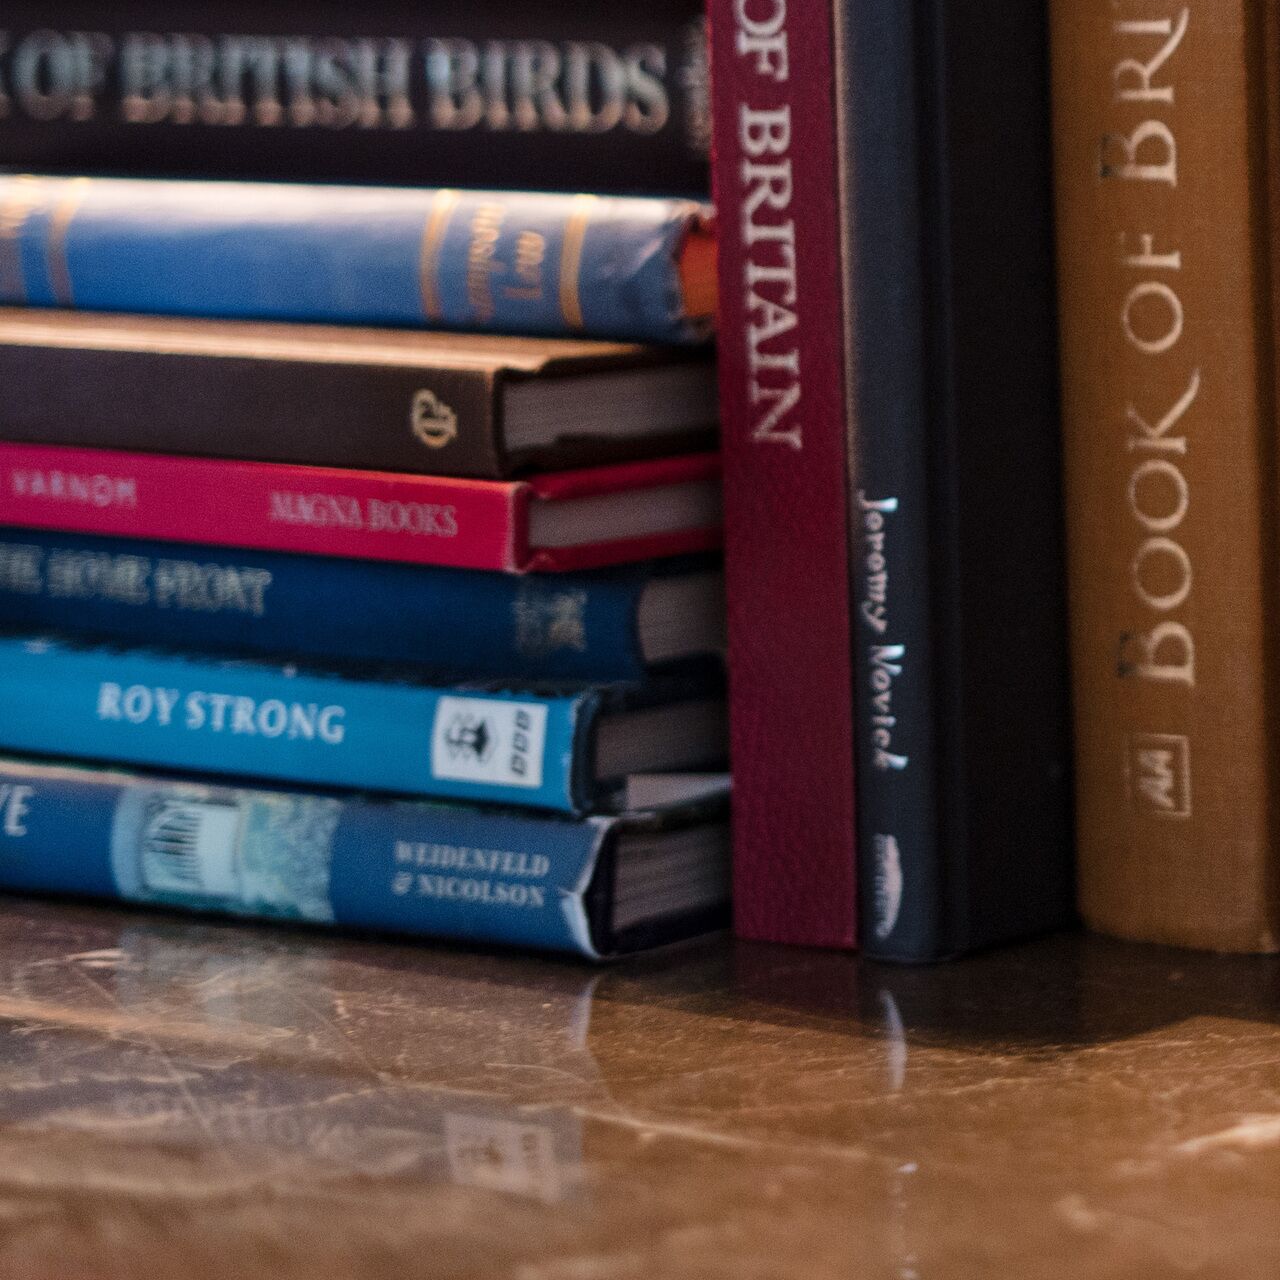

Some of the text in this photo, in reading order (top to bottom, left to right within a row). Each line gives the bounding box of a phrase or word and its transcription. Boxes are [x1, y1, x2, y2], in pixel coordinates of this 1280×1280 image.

[121, 30, 414, 127] BRITISH
[427, 36, 670, 135] BIRDS
[739, 103, 804, 449] BRITAIN
[1119, 232, 1183, 354] OF
[268, 490, 363, 529] MAGNA
[367, 498, 459, 538] BOOKS
[1116, 367, 1200, 687] BOOK
[858, 489, 908, 771] Jeremy Novick
[97, 682, 346, 745] ROY STRONG
[417, 874, 545, 908] NICOLSON
